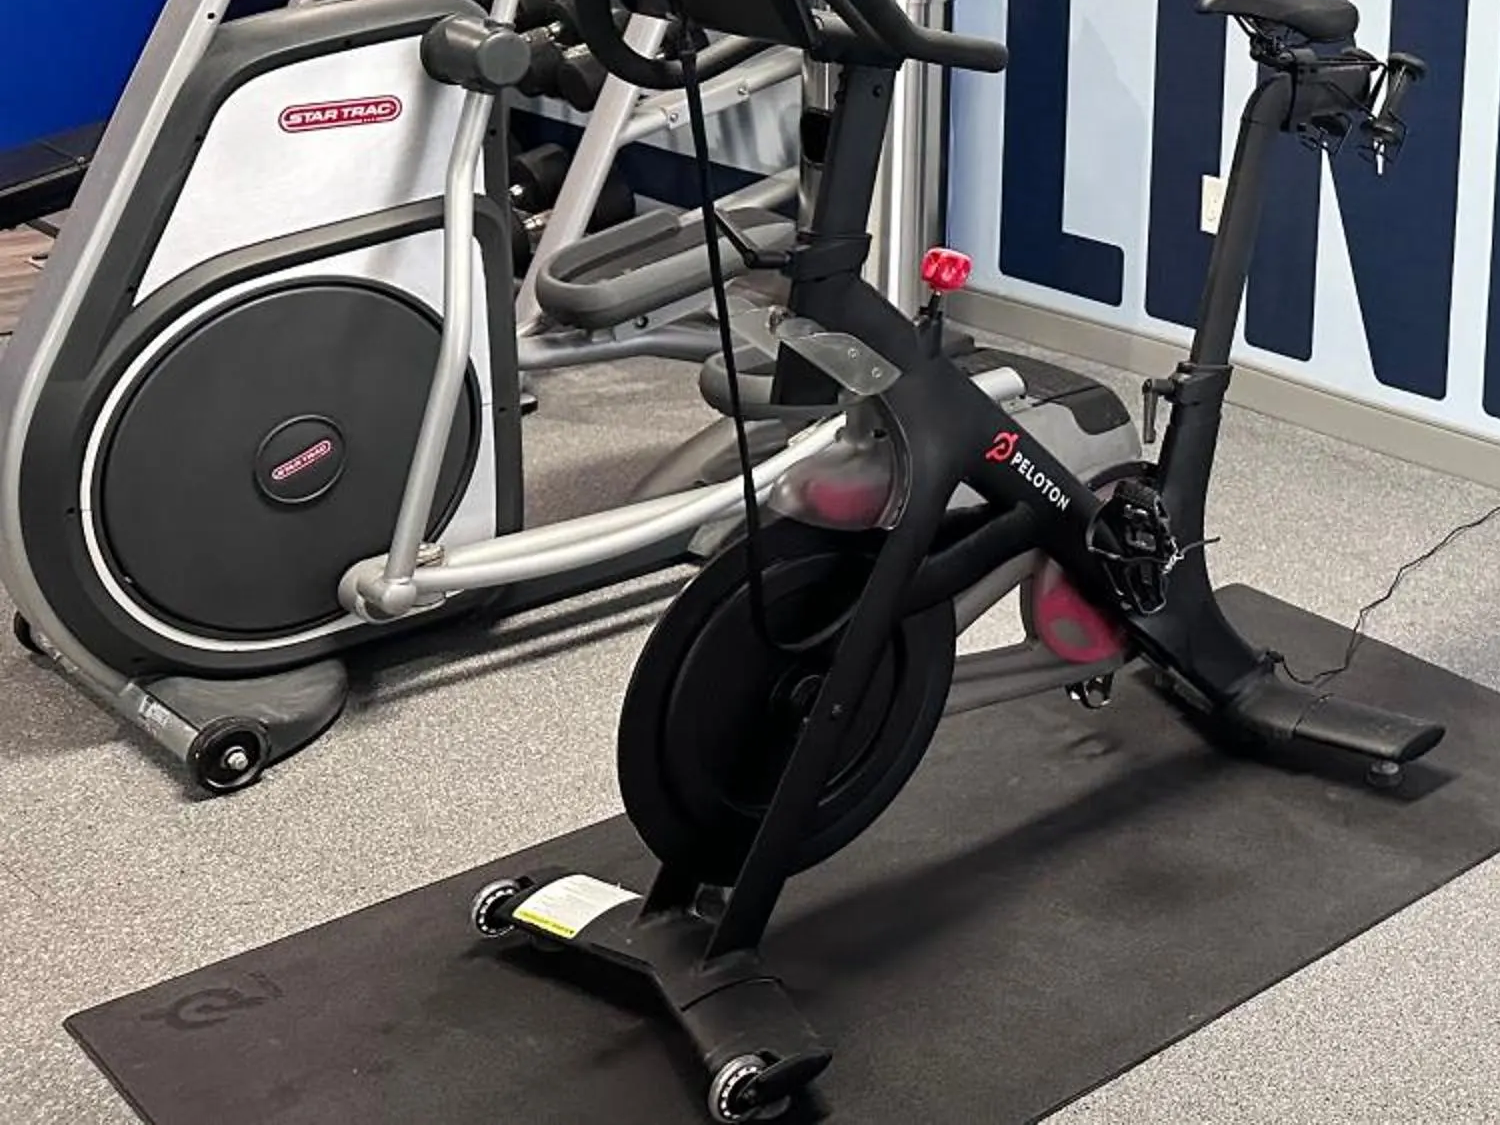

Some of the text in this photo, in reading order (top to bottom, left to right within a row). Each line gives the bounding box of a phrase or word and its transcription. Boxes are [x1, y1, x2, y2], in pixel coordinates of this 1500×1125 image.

[289, 103, 392, 124] STAR TRAC
[1009, 452, 1072, 512] PELOTON
